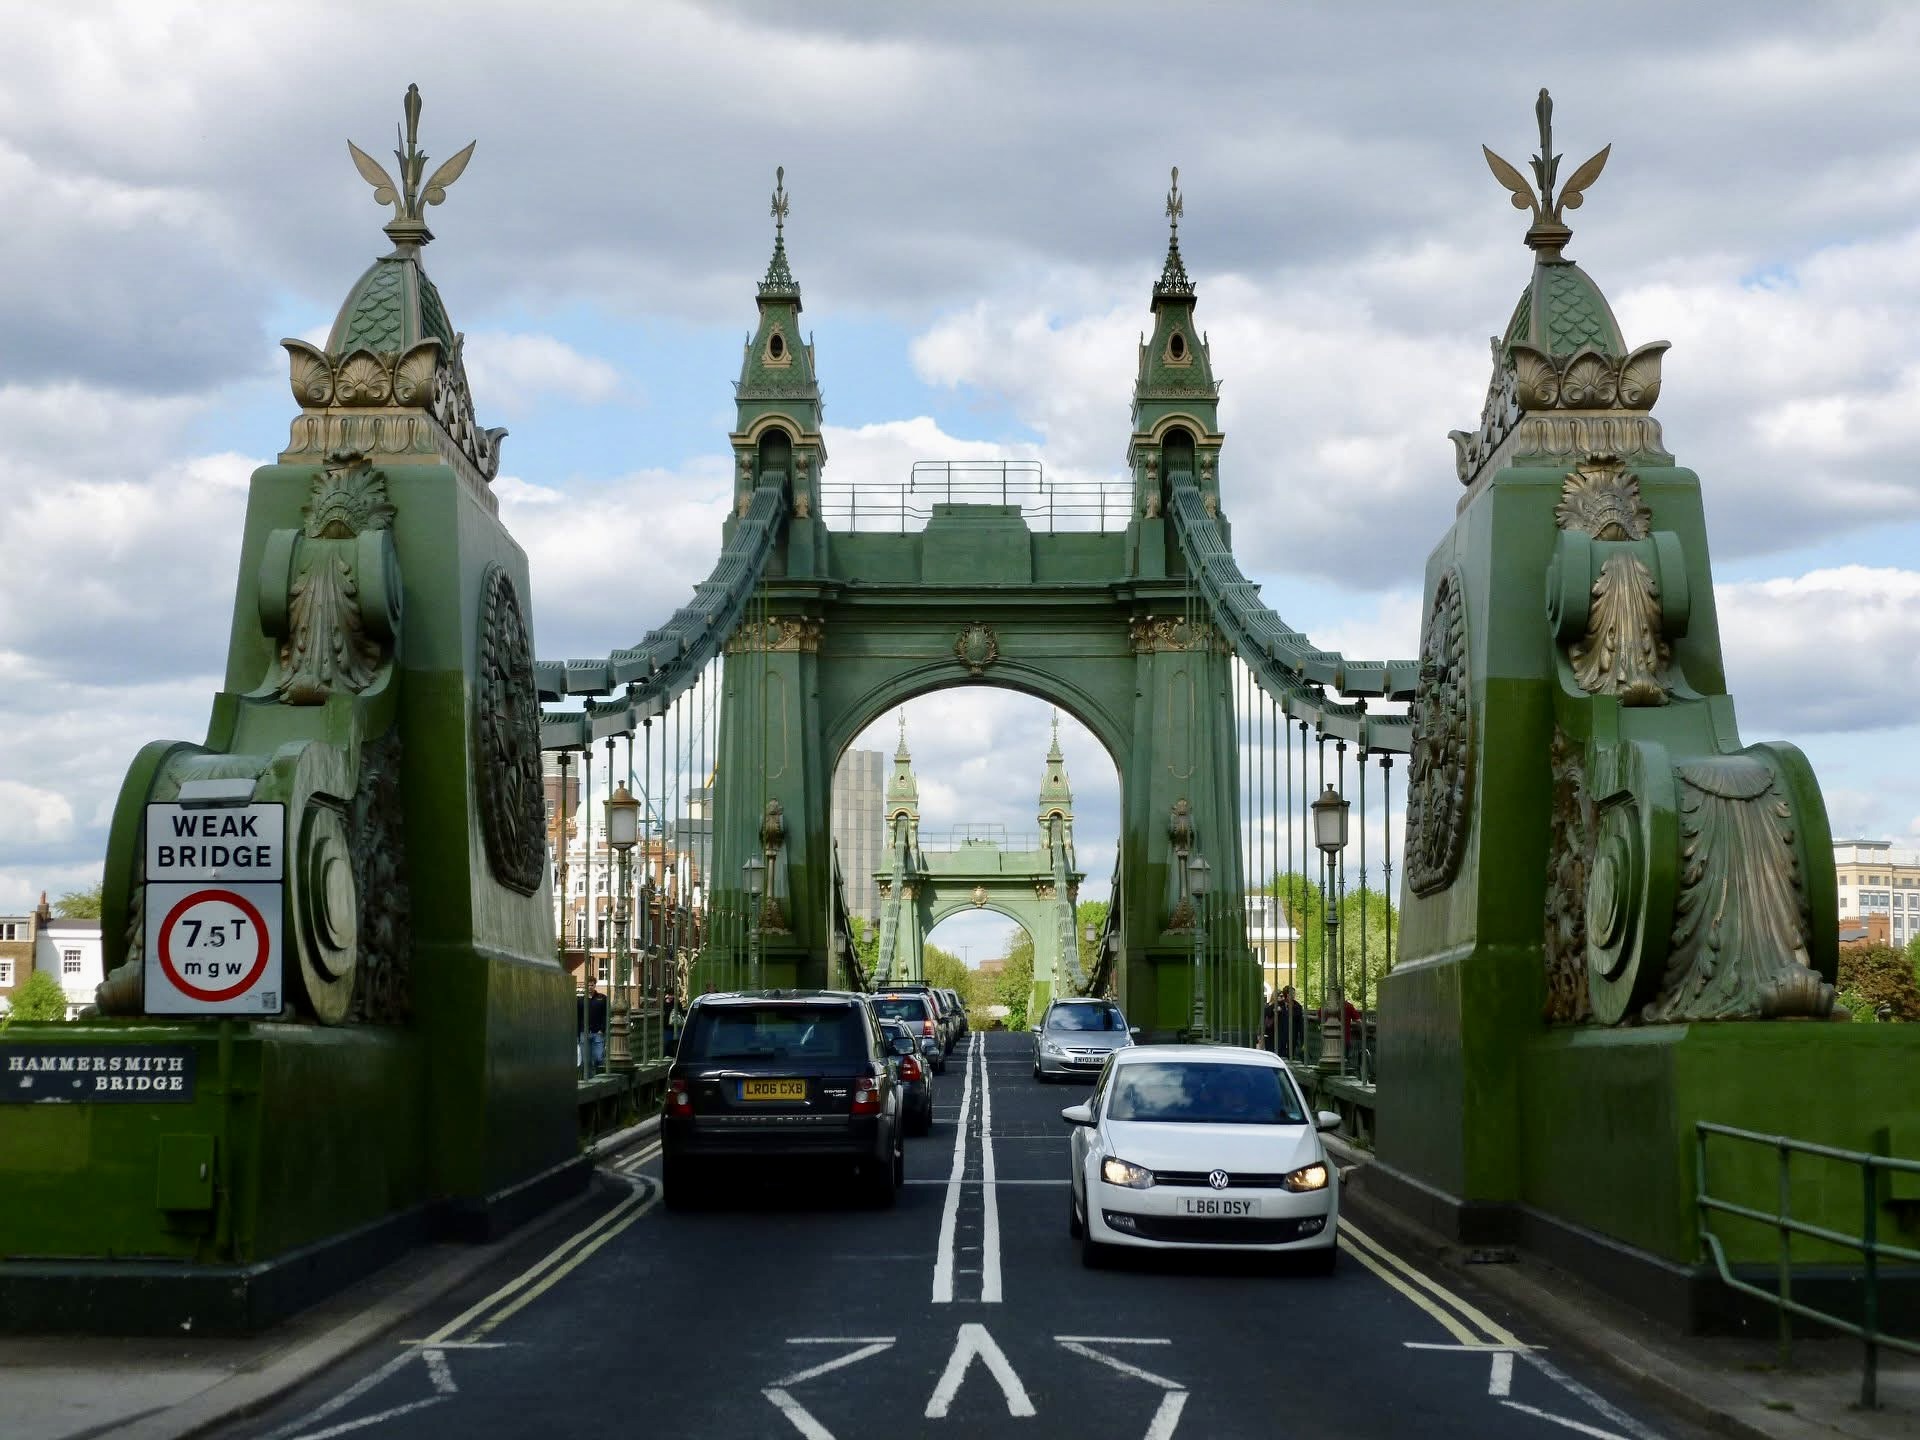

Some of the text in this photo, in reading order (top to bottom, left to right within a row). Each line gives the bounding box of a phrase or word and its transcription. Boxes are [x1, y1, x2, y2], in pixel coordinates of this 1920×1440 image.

[172, 815, 258, 837] WEAK
[158, 845, 271, 868] BRIDGE
[8, 1056, 184, 1072] HAMMERSMITH
[94, 1076, 184, 1091] BRIDGE
[745, 1082, 777, 1095] LR06
[1186, 1199, 1251, 1215] LB61 DSY
